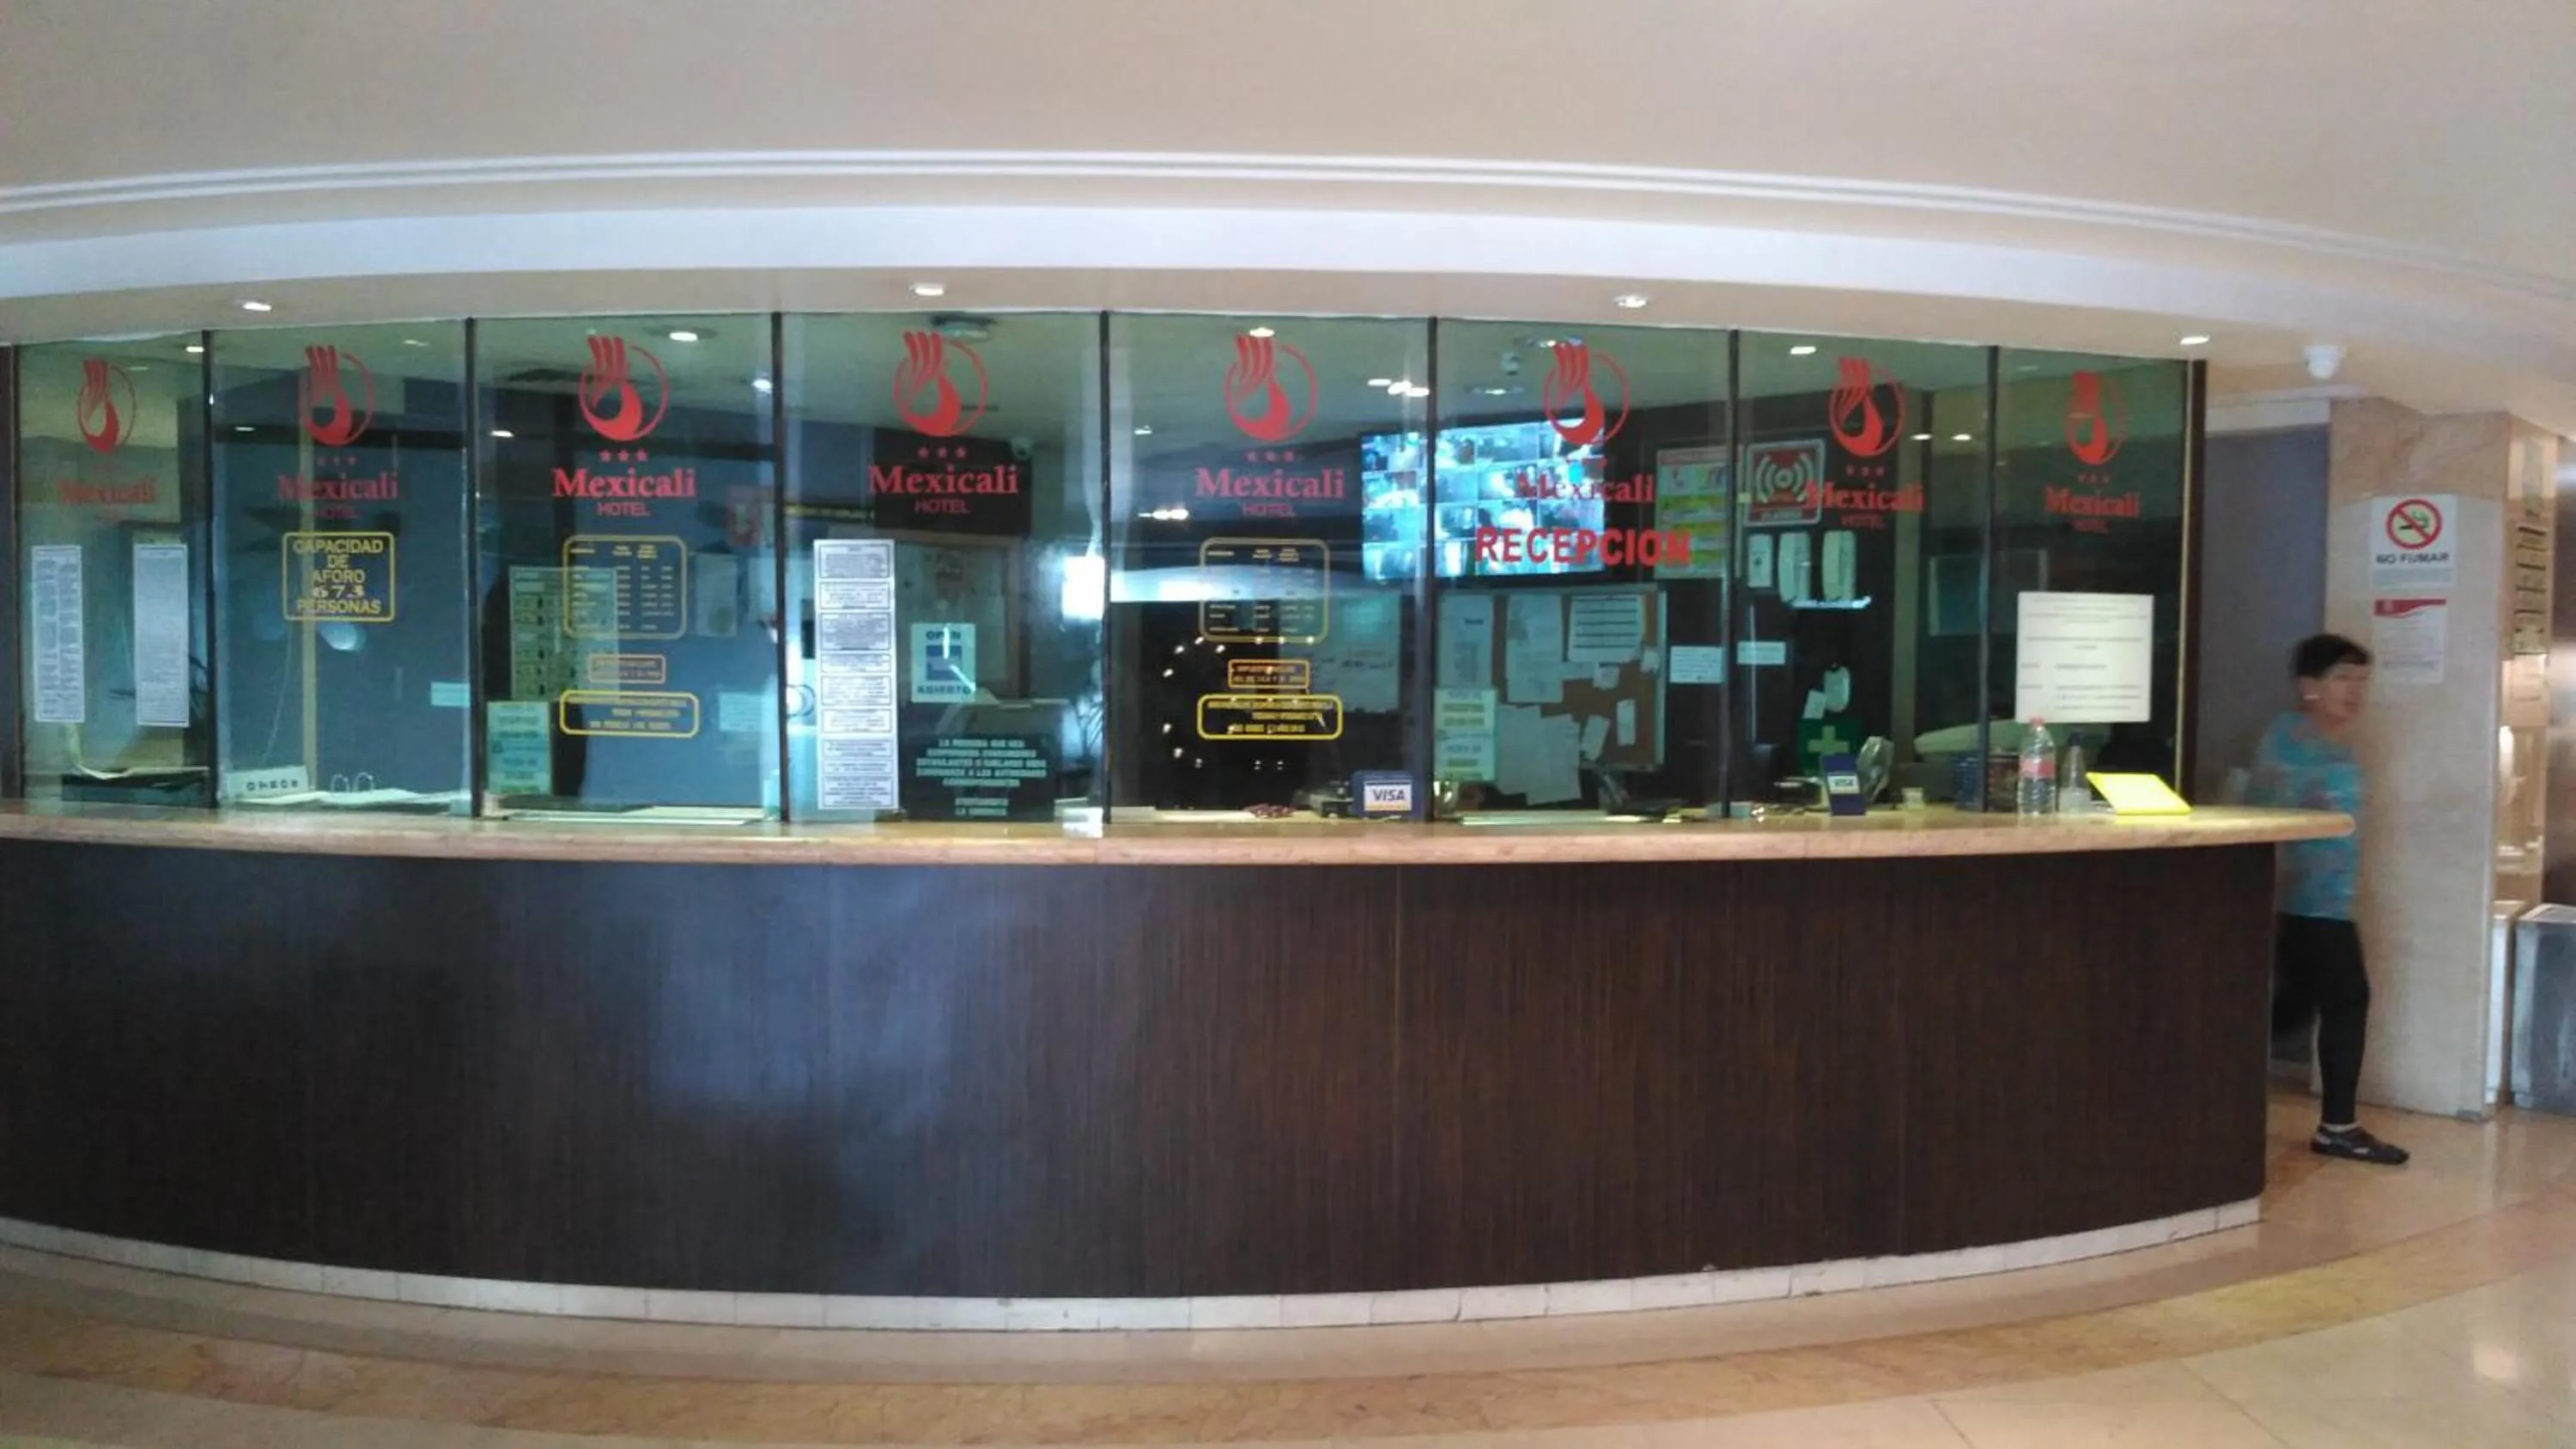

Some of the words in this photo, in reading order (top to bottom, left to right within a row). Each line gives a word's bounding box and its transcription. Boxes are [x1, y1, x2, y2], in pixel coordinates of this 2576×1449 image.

[277, 471, 398, 500] Mexicali
[552, 467, 696, 497] Mexicali
[868, 464, 1018, 494] Mexicali
[1195, 467, 1346, 498] Mexicali
[1804, 478, 1923, 512] Mexicali
[2045, 487, 2140, 518] Mexicali
[598, 501, 650, 516] HOTEL
[914, 499, 969, 513] HOTEL
[1242, 503, 1296, 517] HOTEL
[293, 539, 384, 554] CAPACIDAD
[1475, 526, 1691, 569] RECEPCION
[327, 555, 349, 567] DE
[2376, 554, 2396, 565] NO
[2400, 552, 2450, 564] FUMAR
[313, 570, 366, 583] AFORO
[297, 599, 381, 614] PERSONAS
[926, 630, 961, 640] OPN
[1372, 789, 1406, 801] VISA
